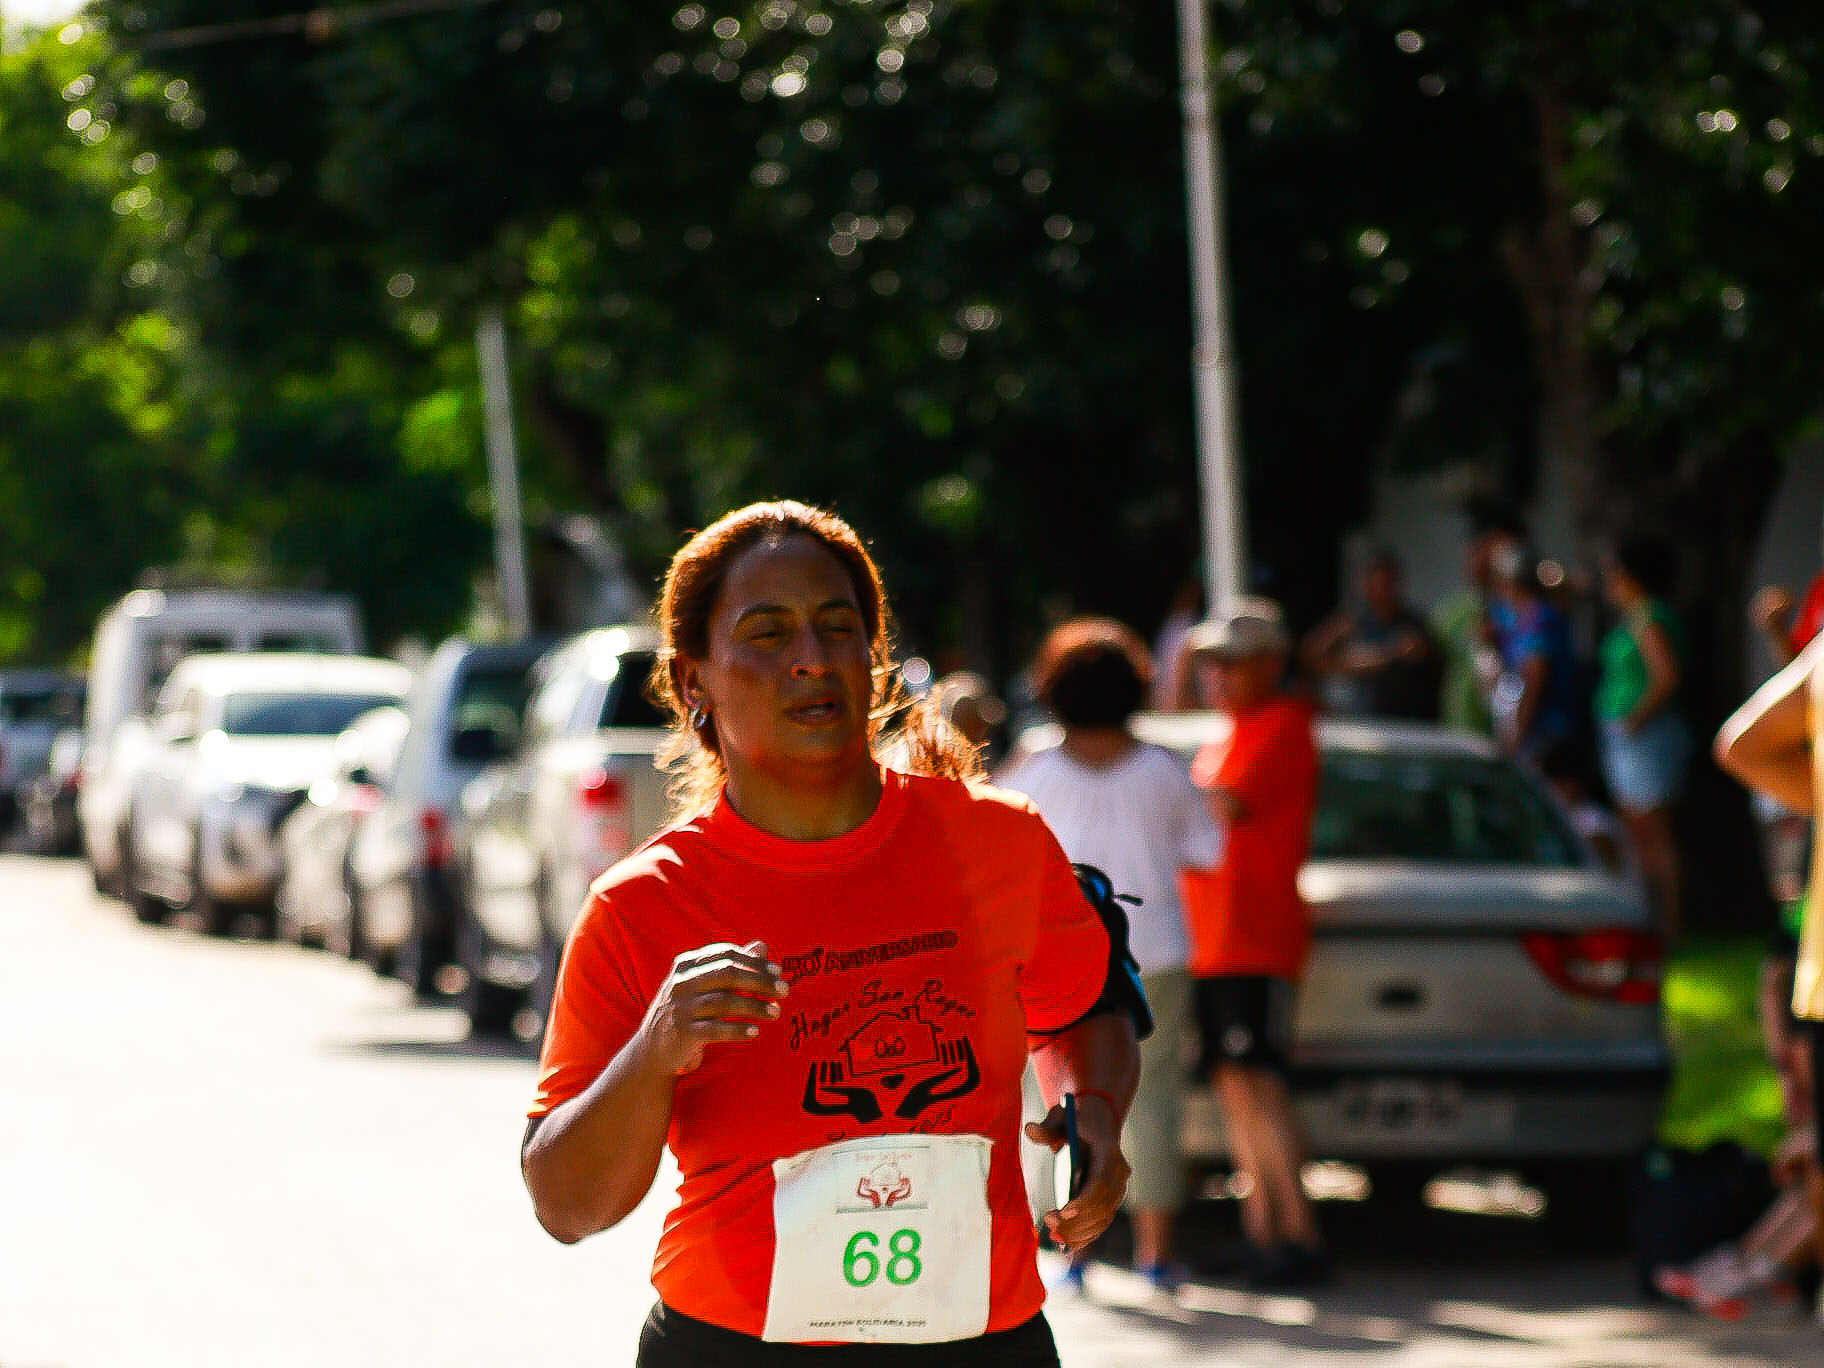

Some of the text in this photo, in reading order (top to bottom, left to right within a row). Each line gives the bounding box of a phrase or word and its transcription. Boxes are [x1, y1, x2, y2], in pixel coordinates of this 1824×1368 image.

[790, 1001, 850, 1050] Hogar
[858, 981, 904, 1008] San
[843, 1228, 922, 1288] 68
